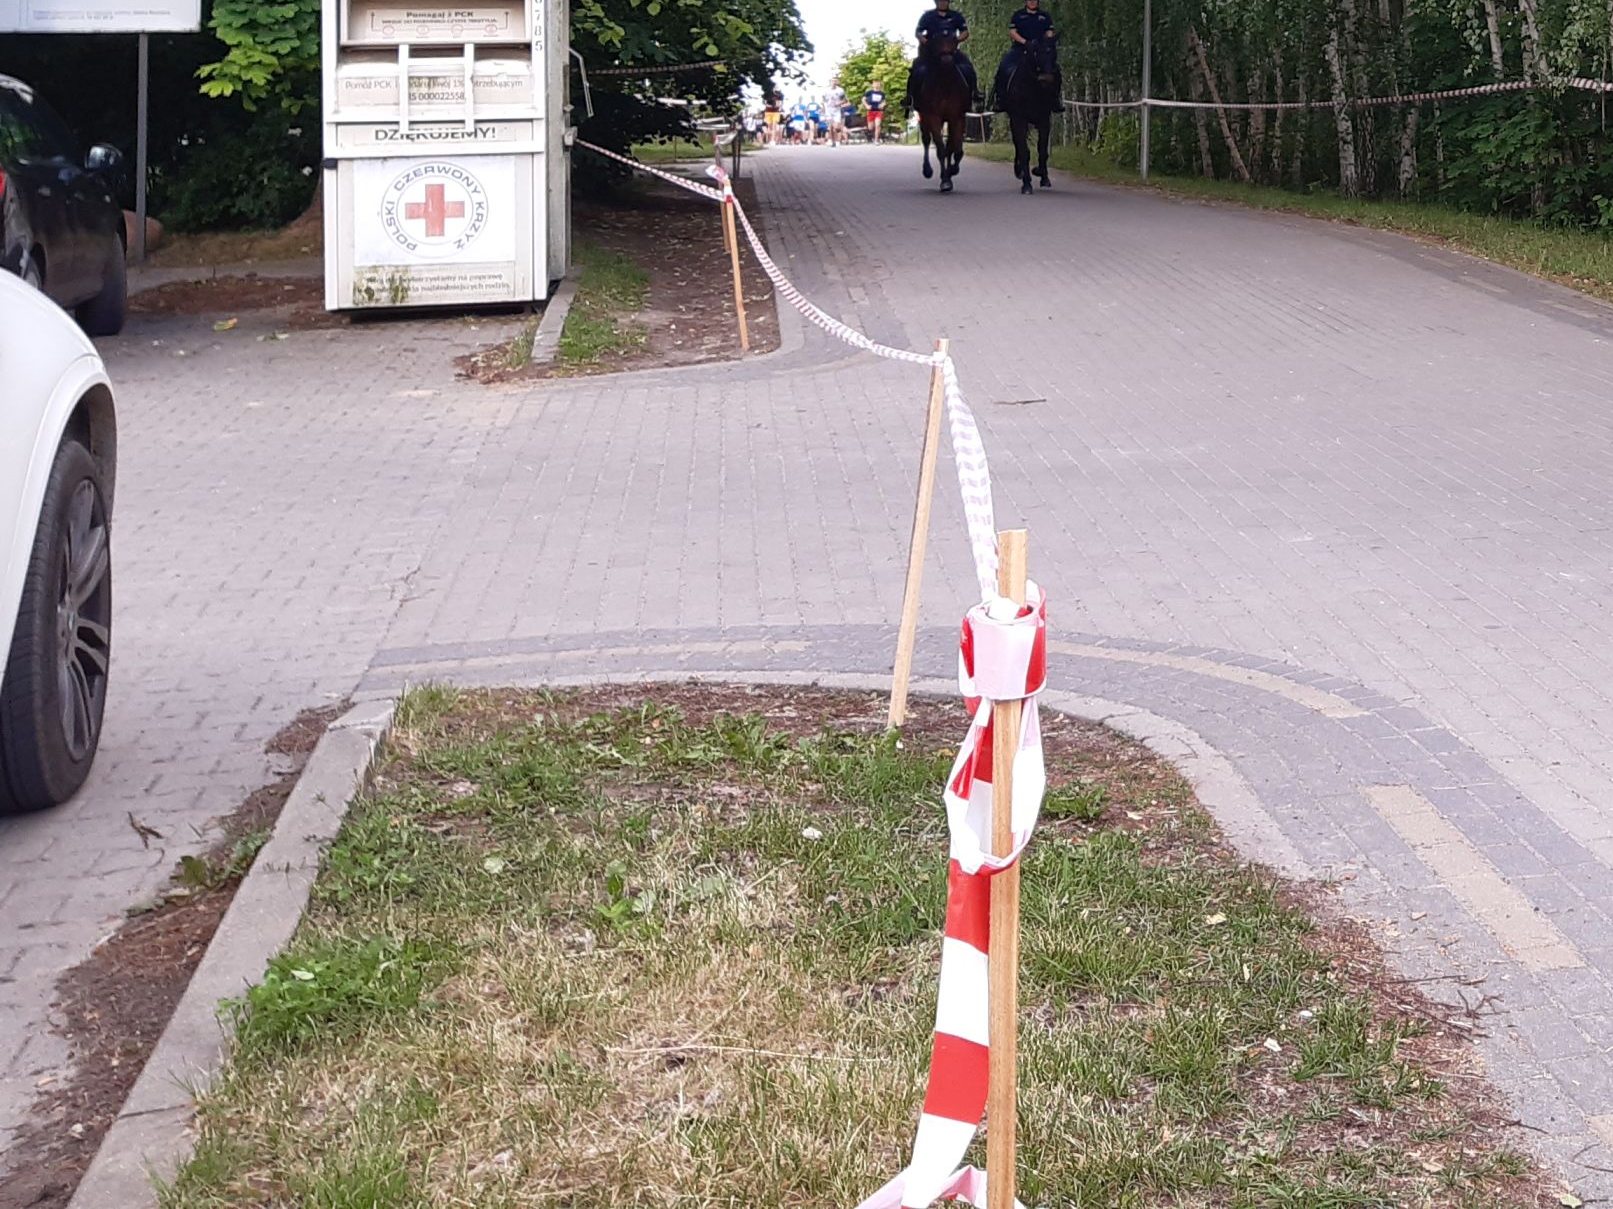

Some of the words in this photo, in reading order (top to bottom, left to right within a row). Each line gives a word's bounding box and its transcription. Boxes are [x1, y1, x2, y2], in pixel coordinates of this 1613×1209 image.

[345, 81, 373, 90] Pomóż
[374, 81, 392, 89] PCK
[394, 165, 481, 194] CZERWONY
[385, 201, 418, 251] POLSKI
[453, 201, 485, 251] KRZYŻ
